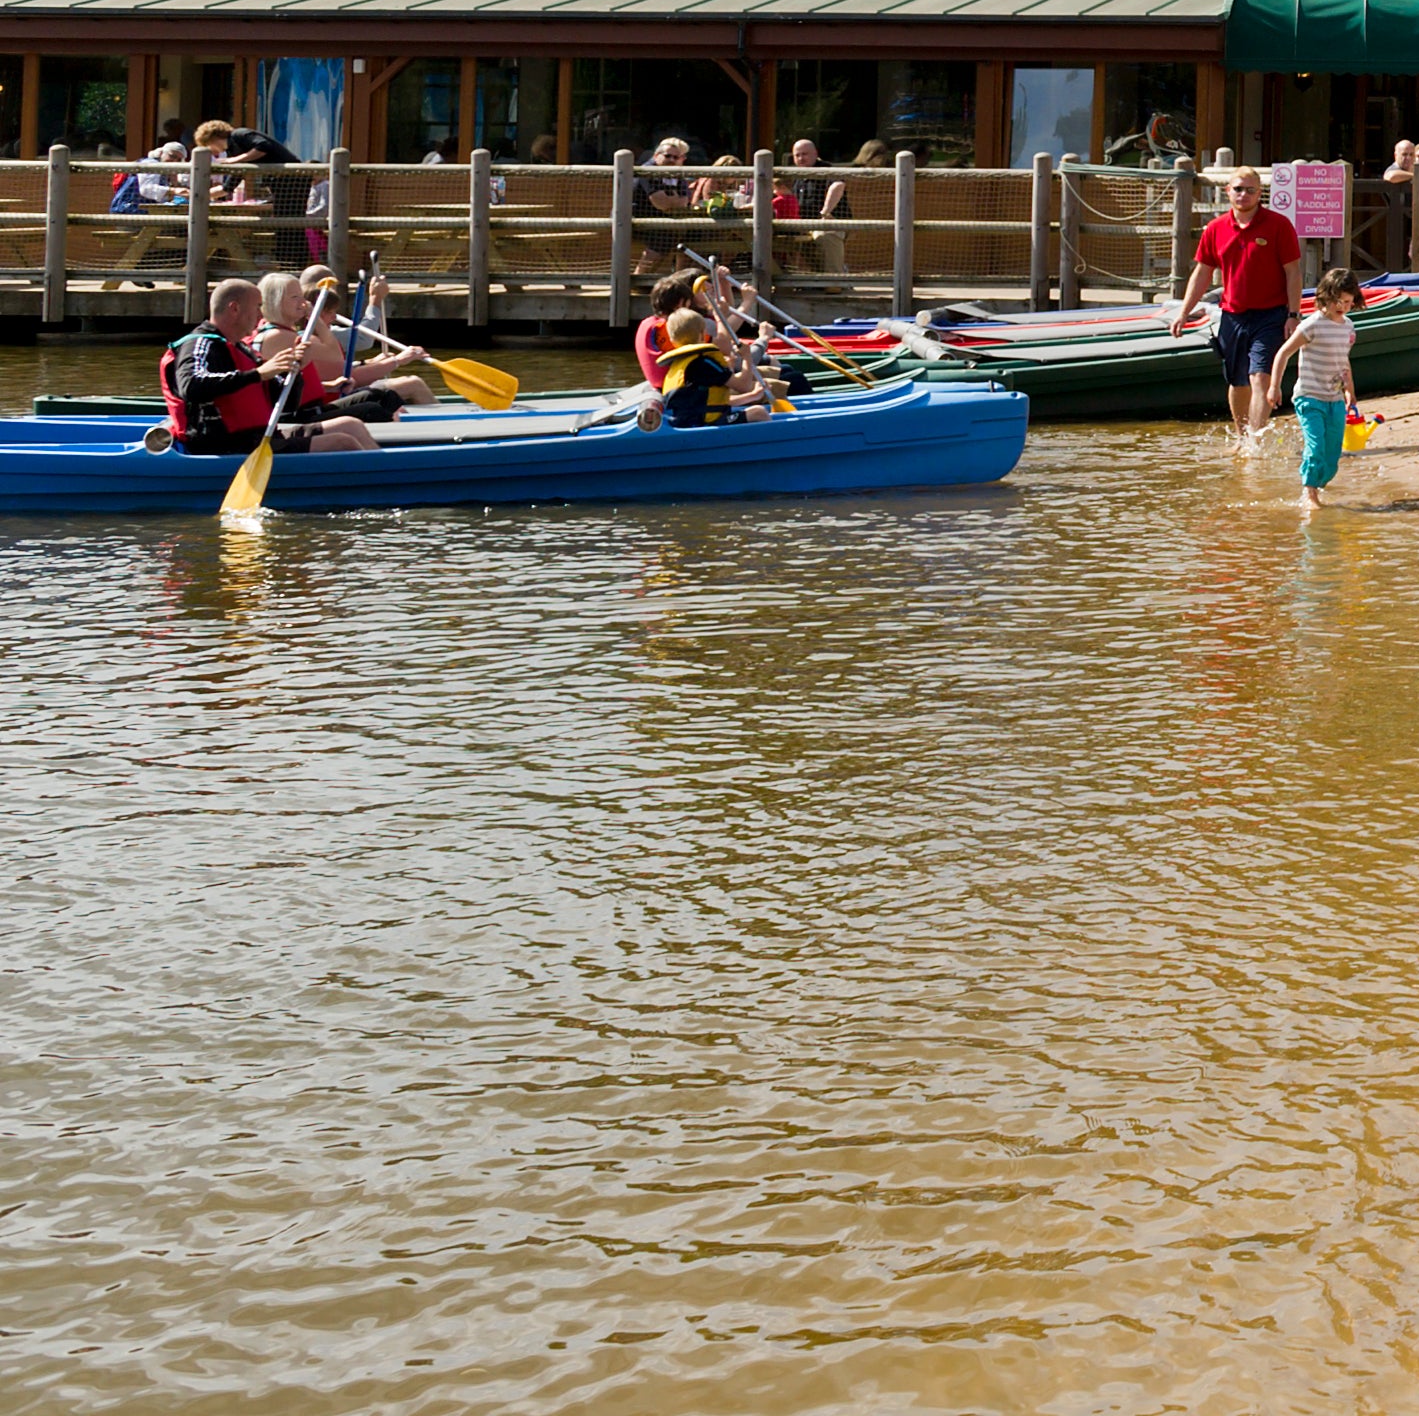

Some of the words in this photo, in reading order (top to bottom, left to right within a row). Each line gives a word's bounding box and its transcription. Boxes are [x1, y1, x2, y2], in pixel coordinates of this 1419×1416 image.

[1314, 168, 1327, 176] NO
[1298, 177, 1342, 185] SWIMMING
[1313, 193, 1327, 201] NO
[1313, 217, 1326, 225] NO
[1305, 225, 1334, 233] DIVING
